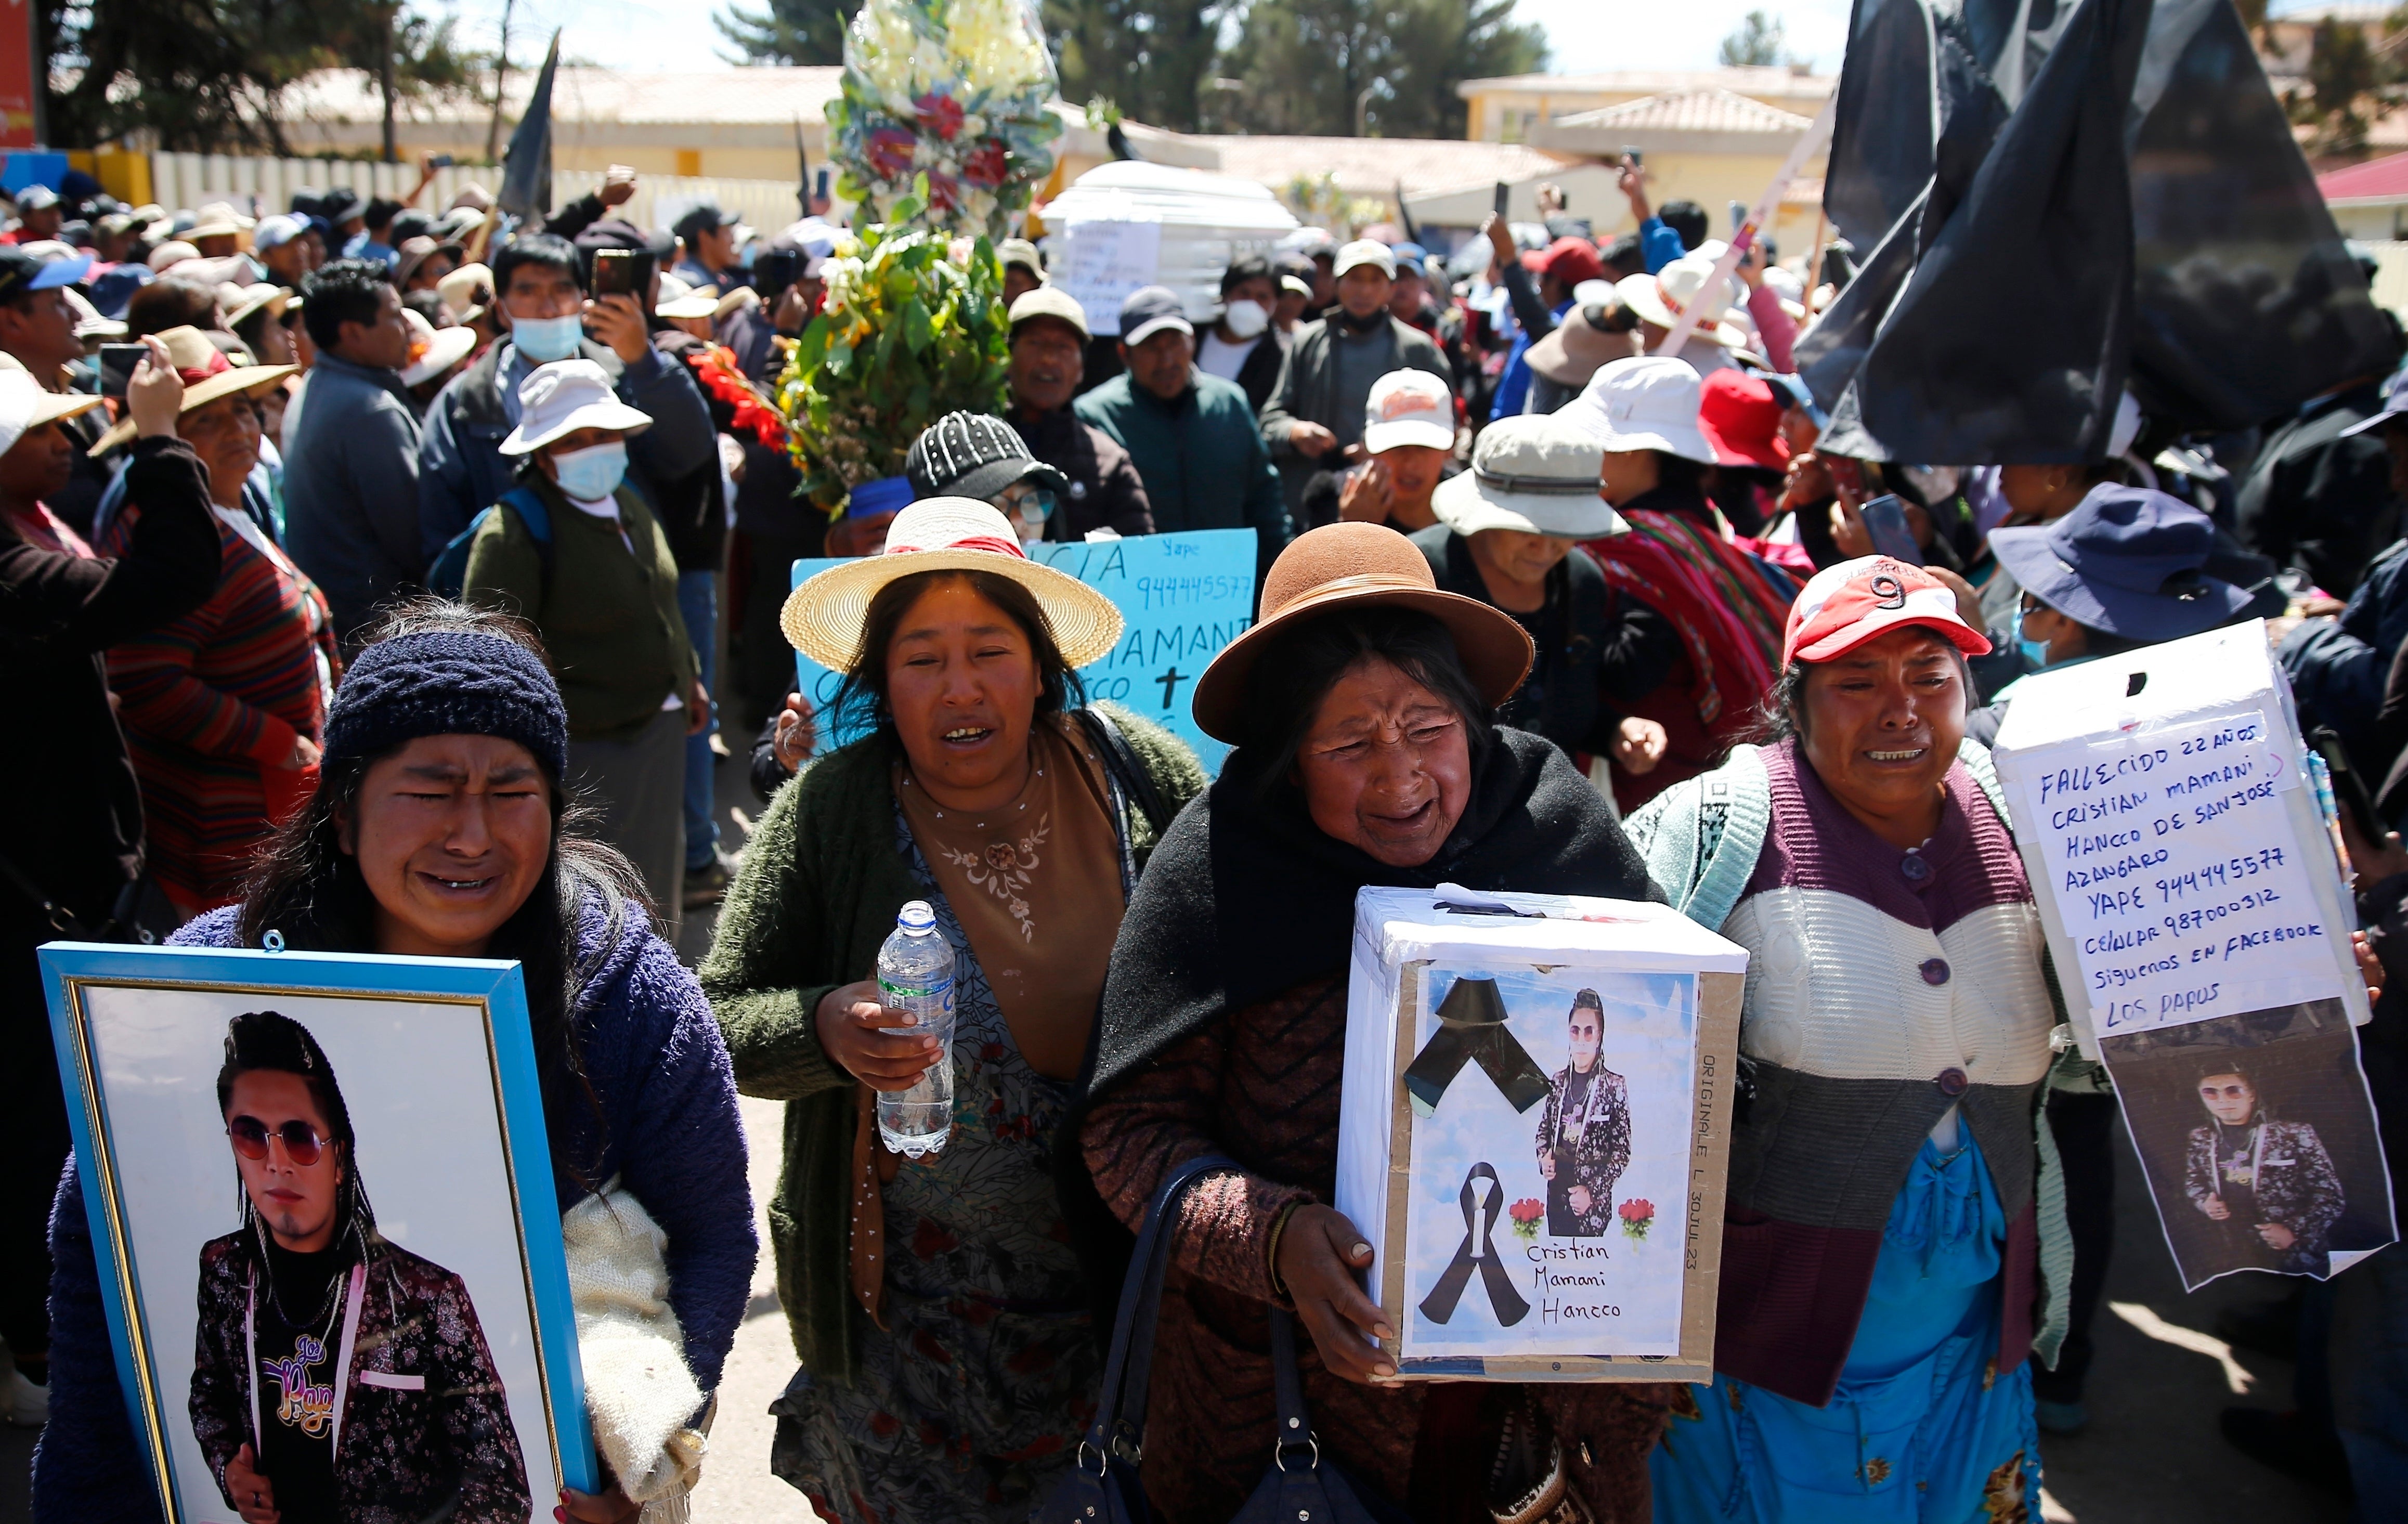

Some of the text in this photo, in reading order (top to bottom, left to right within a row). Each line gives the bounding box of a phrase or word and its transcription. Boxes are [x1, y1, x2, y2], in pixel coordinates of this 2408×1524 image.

[1137, 575, 1252, 610] 944445577
[1870, 574, 1906, 609] 9
[2180, 737, 2207, 755] 22
[2213, 724, 2257, 749] AÑOS
[2066, 830, 2141, 858] HANCCO
[2153, 813, 2185, 836] DE
[2066, 849, 2169, 892] AZANGARO
[2087, 847, 2287, 920] YAPE 944445577
[2164, 889, 2281, 937] 987000312
[2191, 944, 2216, 962] EN
[2223, 924, 2323, 961] FACEBOOK
[2107, 998, 2147, 1027] LOS
[1686, 1054, 1716, 1270] ORIGINALE L 30JUL23
[1527, 1237, 1610, 1262] Cristian
[1534, 1265, 1606, 1294] Mamani
[1543, 1297, 1621, 1325] Hancco
